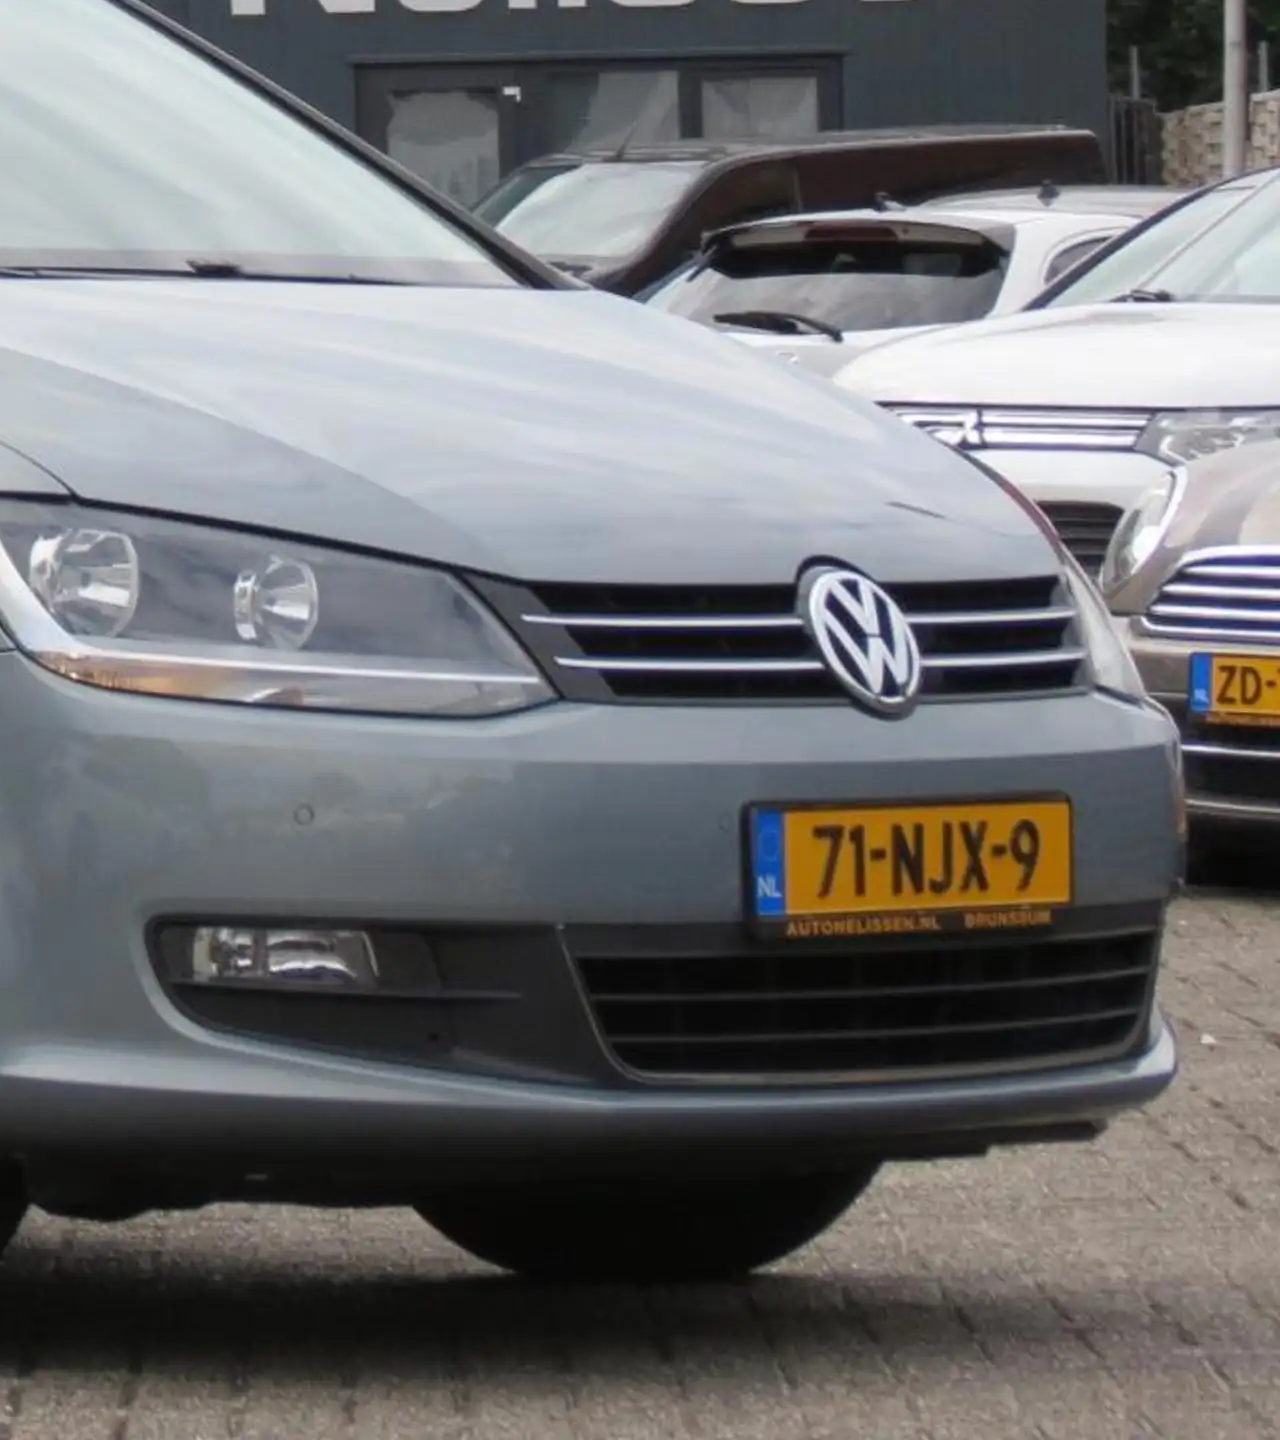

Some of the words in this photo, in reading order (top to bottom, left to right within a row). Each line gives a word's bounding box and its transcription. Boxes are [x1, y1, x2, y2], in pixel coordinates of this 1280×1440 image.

[1216, 665, 1280, 706] ZD-
[813, 819, 1040, 899] 71-NJX-9
[757, 875, 783, 898] NL
